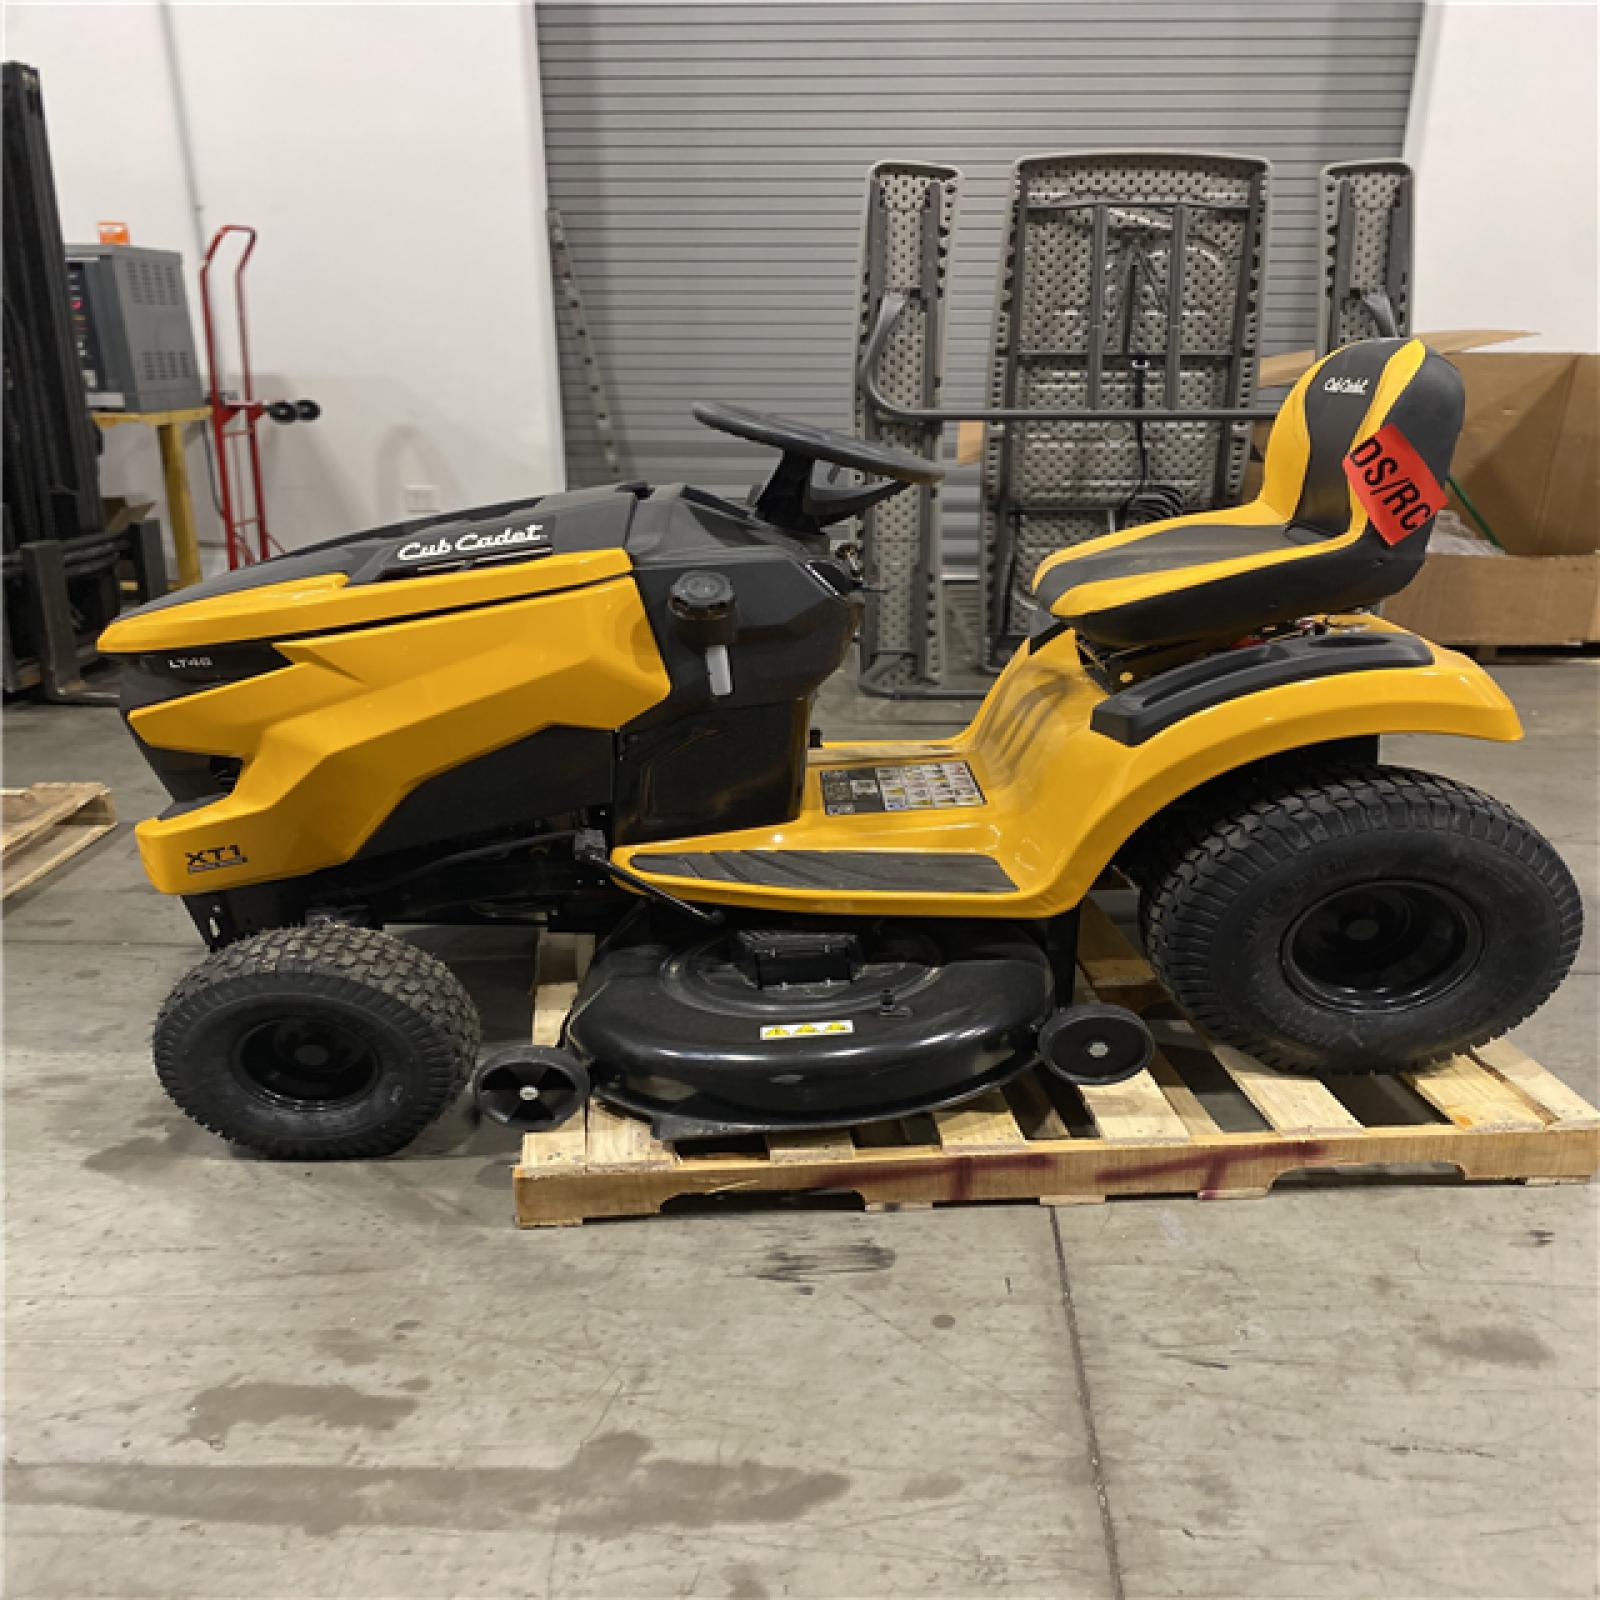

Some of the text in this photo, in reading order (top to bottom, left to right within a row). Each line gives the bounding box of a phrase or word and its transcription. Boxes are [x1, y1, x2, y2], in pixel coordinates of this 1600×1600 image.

[1350, 435, 1431, 531] DS/RC
[397, 523, 545, 561] Cub Cadet
[185, 844, 241, 866] XT1
